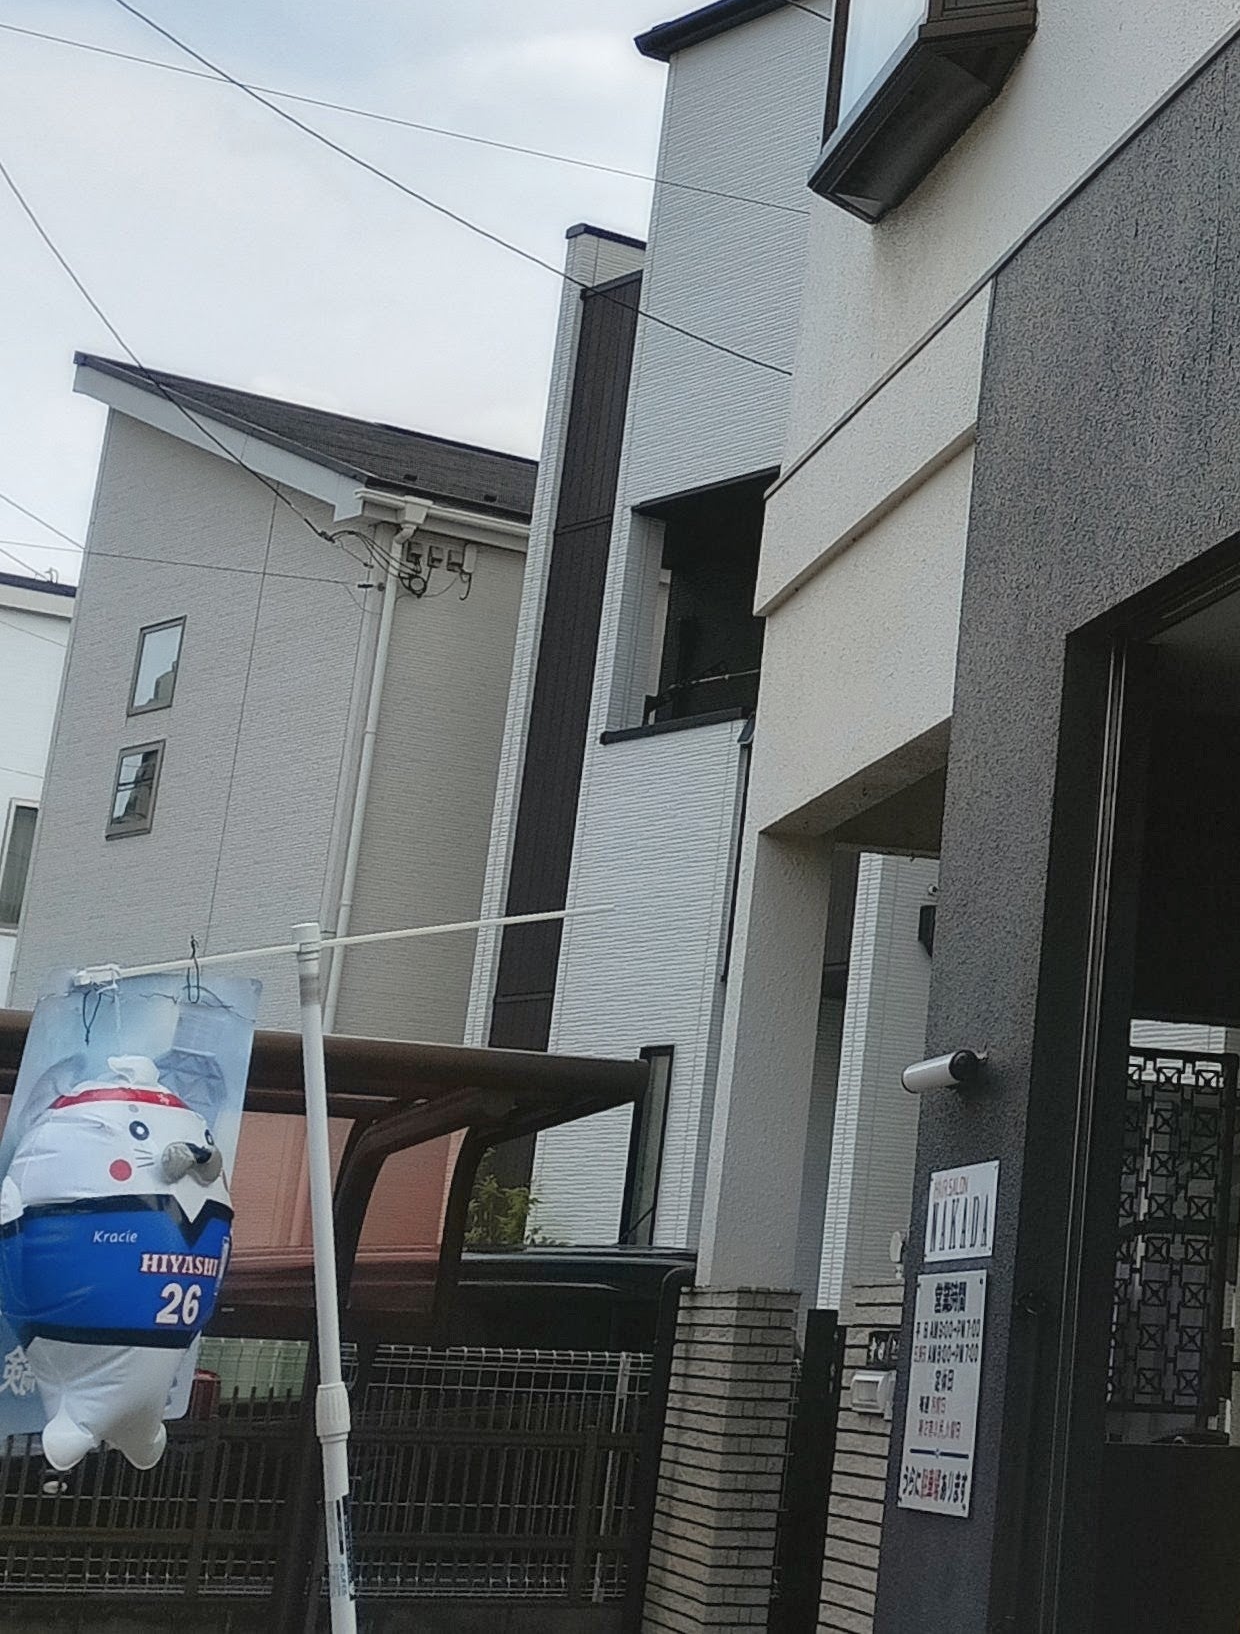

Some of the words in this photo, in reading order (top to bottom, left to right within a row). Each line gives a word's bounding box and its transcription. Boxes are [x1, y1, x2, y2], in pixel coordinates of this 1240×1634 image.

[92, 1229, 139, 1244] Kracie
[930, 1193, 989, 1253] NAKADA
[139, 1253, 220, 1277] HIYASHI
[155, 1282, 202, 1325] 26
[934, 1280, 967, 1314] 営業時間
